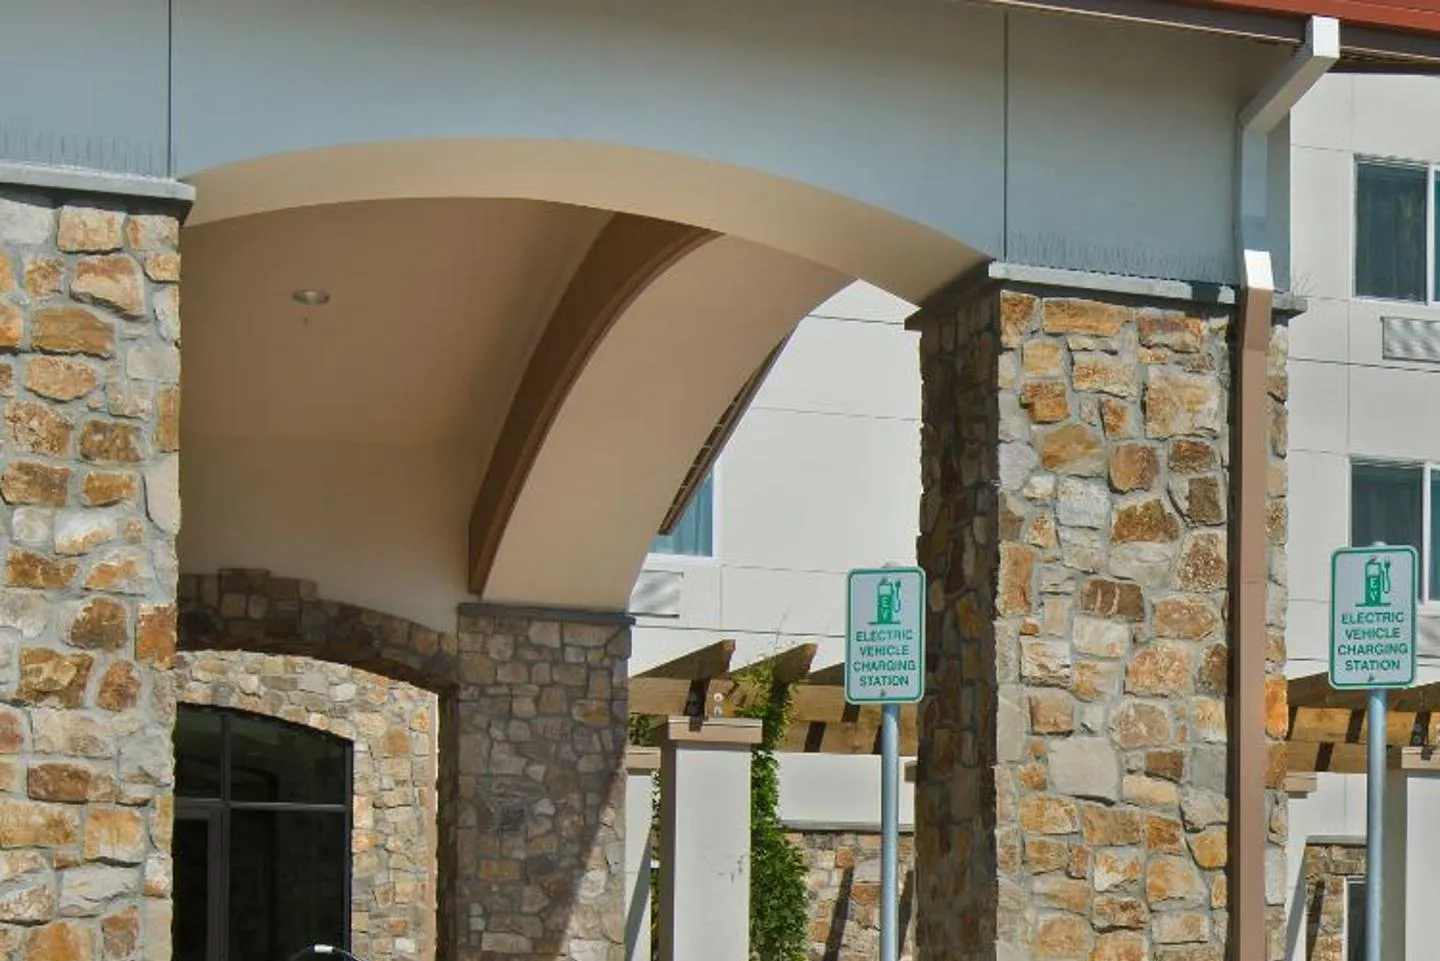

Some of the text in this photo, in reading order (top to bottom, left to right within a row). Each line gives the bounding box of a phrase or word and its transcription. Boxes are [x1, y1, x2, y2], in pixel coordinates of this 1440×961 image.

[1341, 612, 1405, 625] ELECTRIC
[856, 629, 913, 642] ELECTRIC
[1345, 627, 1401, 640] VEHICLE
[860, 645, 909, 657] VEHICLE
[1338, 643, 1408, 656] CHARGING
[853, 660, 916, 672] CHARGING
[1345, 659, 1400, 671] STATION
[859, 675, 909, 687] STATION
